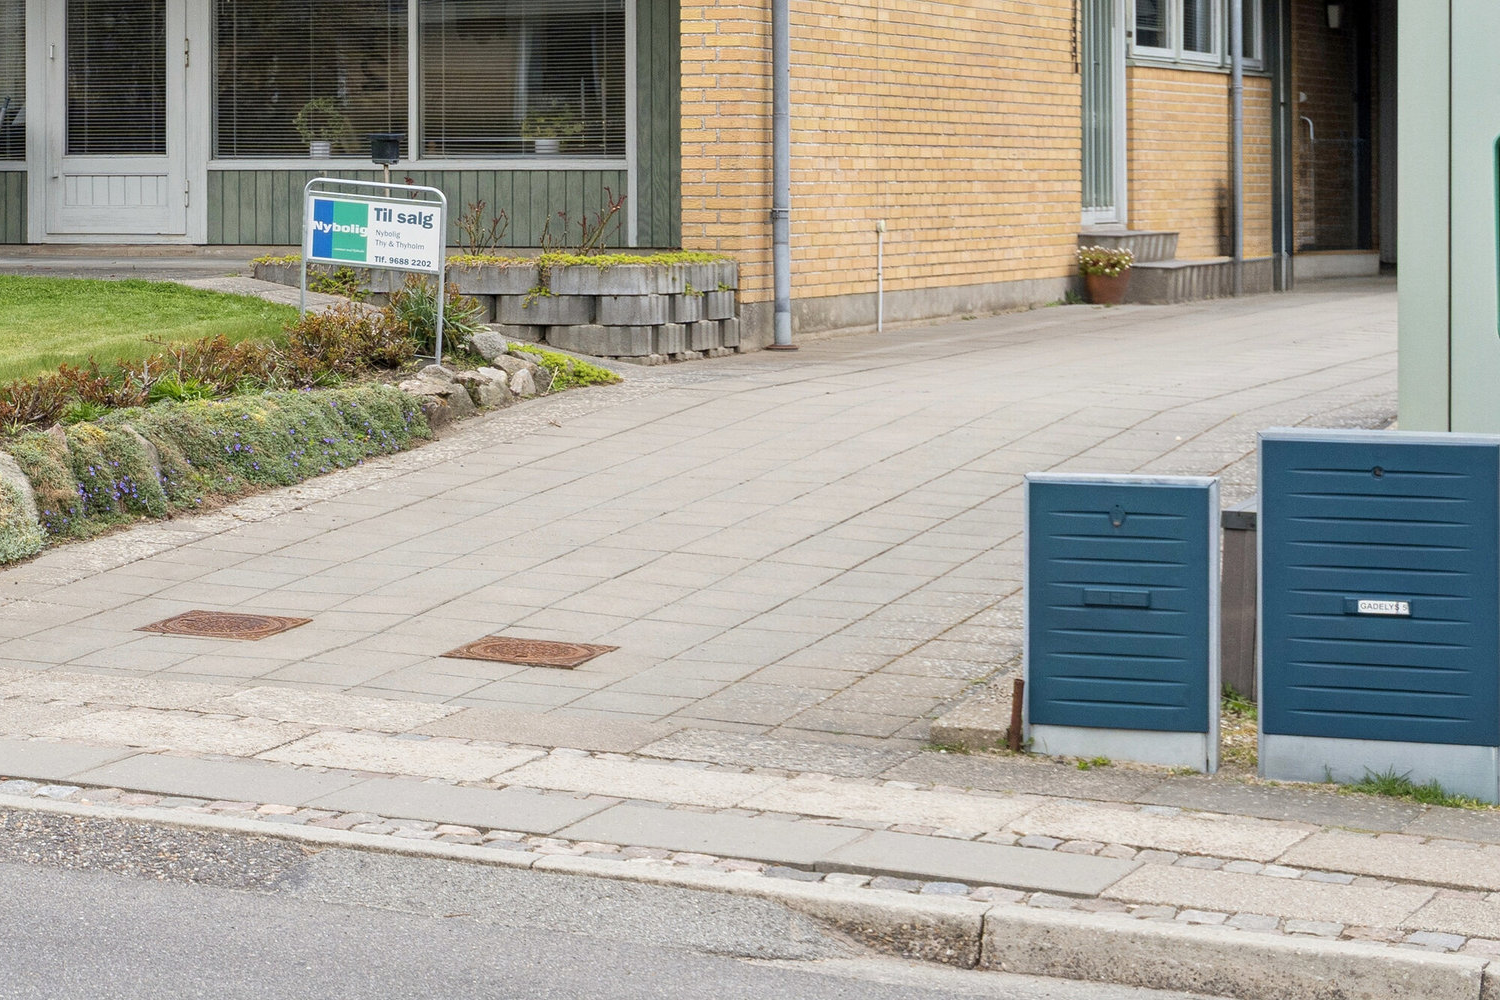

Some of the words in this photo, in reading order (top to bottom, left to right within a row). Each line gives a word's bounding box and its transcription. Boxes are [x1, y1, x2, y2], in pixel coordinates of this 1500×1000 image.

[374, 207, 393, 222] Til
[397, 212, 433, 229] salg
[313, 220, 368, 237] Nybolig
[375, 229, 401, 239] Nybolig
[375, 239, 387, 248] Thy
[396, 241, 425, 250] Thyholm
[374, 255, 387, 263] Tlf.
[411, 259, 431, 267] 2202
